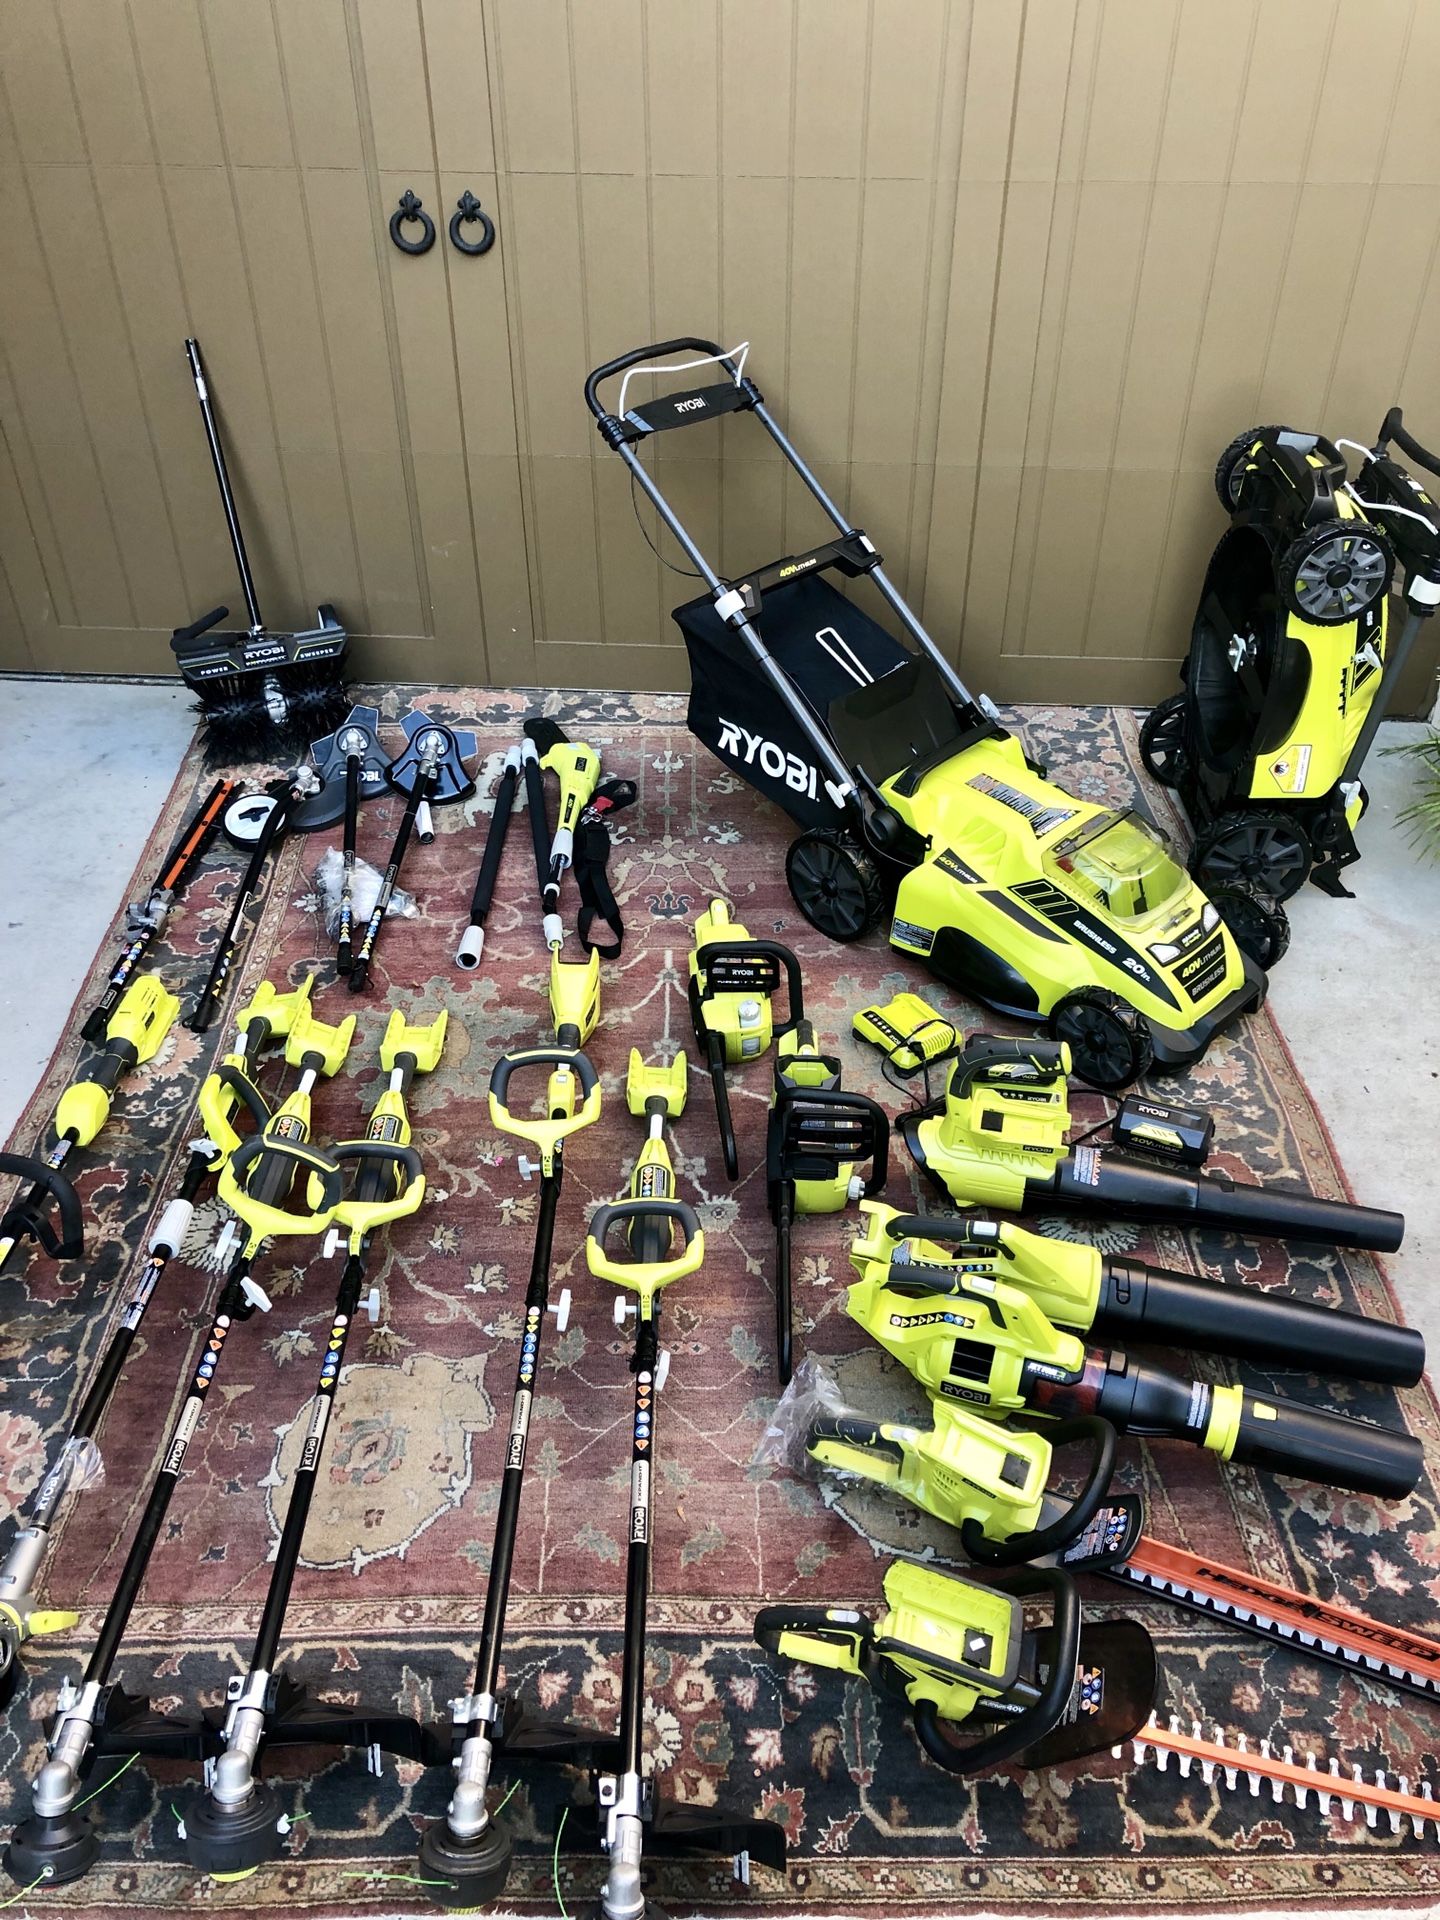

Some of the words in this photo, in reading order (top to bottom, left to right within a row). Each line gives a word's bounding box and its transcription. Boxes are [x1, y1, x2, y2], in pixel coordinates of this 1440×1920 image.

[674, 397, 706, 413] RYOBI
[244, 646, 285, 659] RYOBI
[300, 648, 334, 659] SWEEPER
[200, 666, 229, 676] POWER
[717, 717, 819, 802] RYOBI
[1073, 919, 1118, 954] BRUSHLESS
[1182, 958, 1202, 979] 40V
[1192, 964, 1225, 996] BRUSHLESS
[1138, 1105, 1170, 1118] RYOBI
[1131, 1136, 1153, 1146] 40V
[943, 1383, 988, 1402] RYOBI
[168, 1440, 186, 1469] RYOBI
[302, 1438, 317, 1466] RYOBI
[509, 1435, 523, 1464] RYOBI
[36, 1475, 60, 1511] RYOBI
[634, 1507, 645, 1538] RYOBI
[1006, 1703, 1025, 1713] 40V
